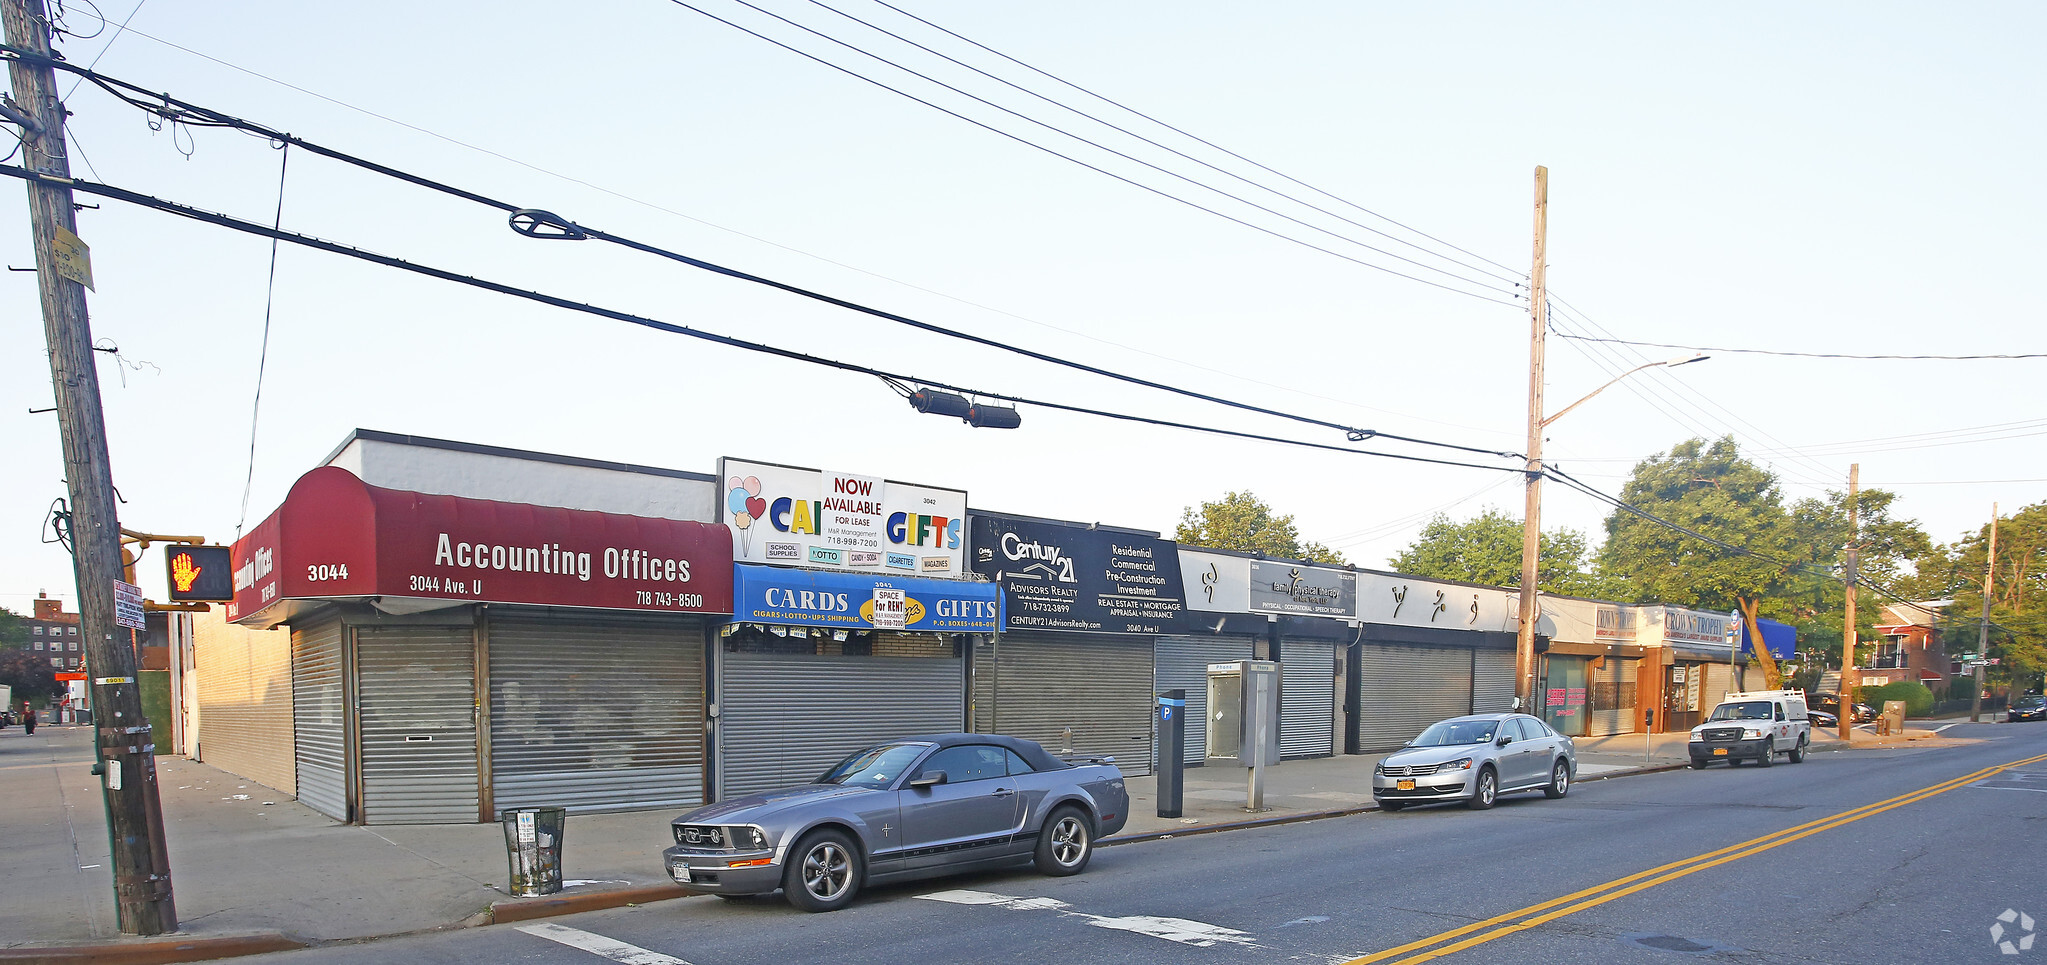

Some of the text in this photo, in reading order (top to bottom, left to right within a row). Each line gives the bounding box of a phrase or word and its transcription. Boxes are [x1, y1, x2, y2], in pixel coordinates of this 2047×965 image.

[834, 477, 873, 496] NOW
[823, 496, 882, 516] AVAILABLE
[835, 516, 871, 526] FOR LEASE
[841, 528, 877, 538] Management
[886, 511, 961, 550] GIFTS
[1001, 532, 1061, 565] Century
[1112, 544, 1152, 558] Residential
[255, 546, 273, 582] Offices
[435, 533, 691, 582] Accounting Offices
[851, 554, 877, 562] CANDY SODA
[888, 556, 914, 566] CIGARETTES
[1111, 558, 1156, 572] Commercial
[307, 564, 349, 582] 3044
[1106, 570, 1166, 585] Pre-Construction
[410, 575, 482, 595] 3044 Ave. U
[1117, 583, 1157, 596] Investment
[1273, 582, 1340, 599] family physical therapy
[636, 590, 703, 608] 718 743-8500
[765, 587, 848, 612] CARDS
[936, 599, 996, 618] GIFTS
[879, 592, 900, 600] SPACE
[876, 600, 904, 612] For RENT
[1024, 602, 1070, 612] 718-732-3899
[1098, 599, 1181, 610] REAL ESTATE MORTGAGE
[1262, 602, 1282, 610] PHYSICAL
[1284, 603, 1312, 612] OCCUPATIONAL
[753, 610, 780, 618] CIGARS
[784, 612, 808, 620] LOTTO
[1110, 608, 1174, 618] APPRAISAL INSURANCE
[1011, 616, 1101, 630] CENTURY21AdvisorsRealty.com
[1126, 624, 1141, 632] 3040
[1666, 612, 1723, 636] CROWN TROPHY
